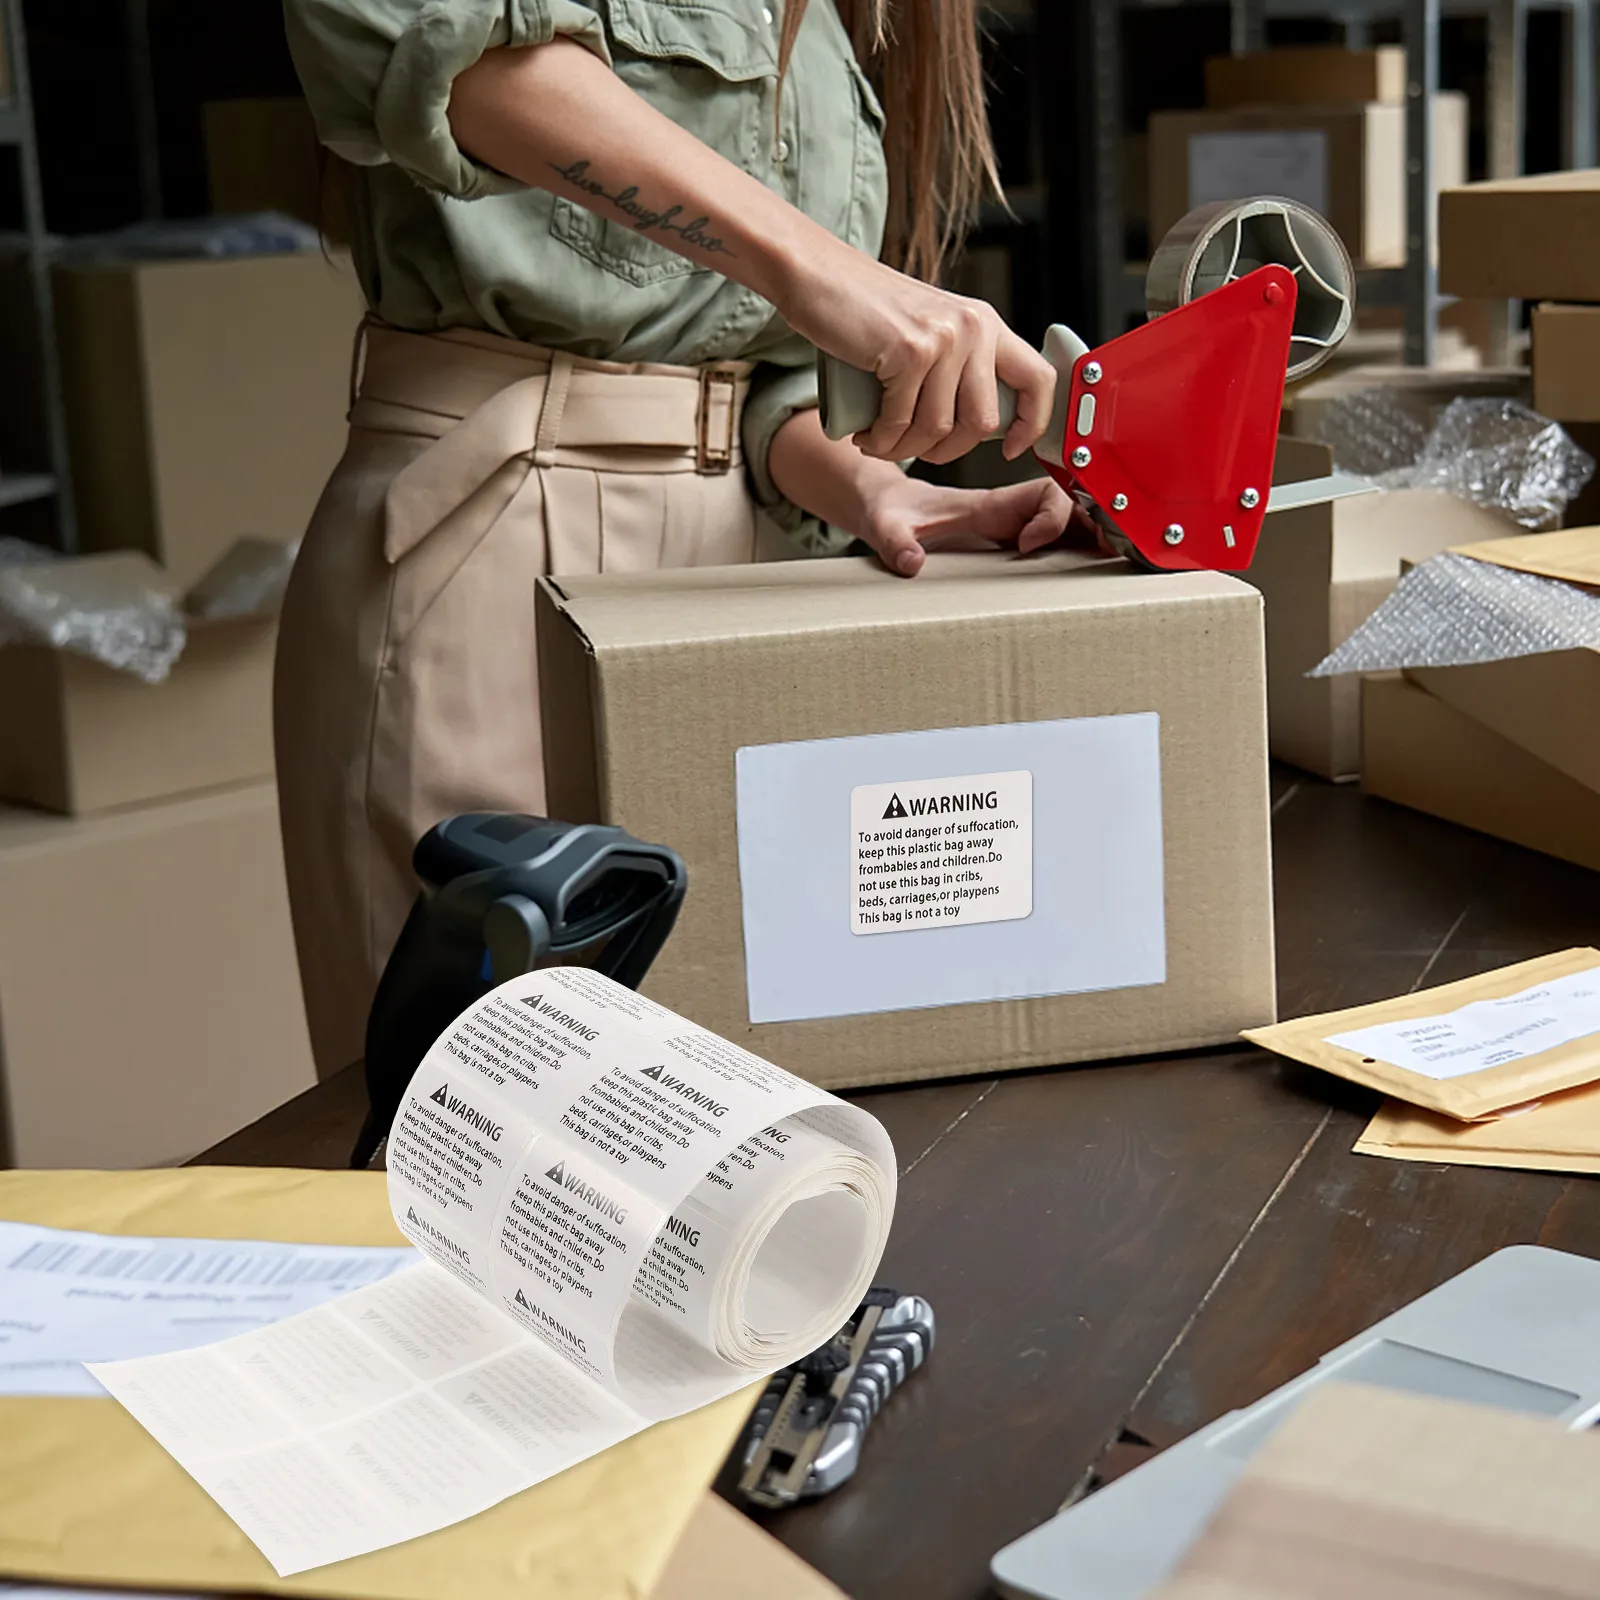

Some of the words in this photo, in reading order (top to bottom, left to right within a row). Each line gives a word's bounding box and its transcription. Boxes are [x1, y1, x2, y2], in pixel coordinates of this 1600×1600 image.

[909, 791, 998, 816] WARNING
[858, 831, 871, 843] To
[873, 828, 902, 842] avoid
[904, 827, 942, 839] danger
[944, 823, 956, 835] of
[957, 820, 1019, 834] suffocation,
[859, 848, 884, 860] keep
[886, 844, 906, 857] this
[908, 841, 942, 857] plastic
[944, 840, 964, 852] bag
[966, 838, 994, 849] away
[859, 860, 918, 876] frombabies
[920, 857, 940, 870] and
[942, 851, 1003, 867] children.Do
[859, 880, 877, 892] not
[879, 880, 897, 890] use
[899, 876, 919, 888] this
[921, 875, 940, 887] bag
[943, 873, 953, 884] in
[955, 870, 983, 883] cribs,
[859, 895, 887, 908] beds,
[889, 891, 951, 905] carriages,or
[953, 886, 1000, 902] playpens
[859, 912, 880, 924] This
[882, 911, 902, 924] bag
[905, 909, 913, 920] is
[915, 907, 933, 919] not
[935, 908, 941, 917] a
[943, 906, 960, 918] toy
[482, 1004, 500, 1018] keep
[498, 1014, 514, 1026] this
[509, 1022, 536, 1039] plastic
[533, 1034, 548, 1048] bag
[546, 1044, 567, 1059] away
[493, 996, 503, 1006] To
[500, 1002, 524, 1017] avoid
[519, 1014, 546, 1031] danger
[543, 1028, 556, 1036] of
[550, 1033, 591, 1060] suffocation,
[507, 1035, 525, 1047] and
[538, 1002, 600, 1042] WARNING
[444, 1041, 459, 1055] This
[457, 1049, 472, 1065] bag
[469, 1057, 478, 1067] is
[476, 1063, 491, 1075] not
[487, 1070, 495, 1078] a
[493, 1073, 507, 1086] toy
[452, 1031, 471, 1048] beds,
[506, 1067, 540, 1090] playpens
[461, 1023, 477, 1034] not
[473, 1030, 487, 1041] use
[485, 1036, 500, 1049] this
[498, 1044, 513, 1058] bag
[511, 1052, 521, 1062] in
[519, 1058, 538, 1074] cribs,
[447, 1095, 504, 1142] WARNING
[599, 1075, 619, 1090] keep
[617, 1086, 634, 1099] this
[629, 1095, 659, 1114] plastic
[656, 1109, 674, 1124] bag
[672, 1120, 695, 1136] away
[610, 1066, 622, 1077] To
[619, 1073, 645, 1089] avoid
[640, 1086, 670, 1105] danger
[667, 1102, 682, 1111] of
[675, 1107, 721, 1138] suffocation,
[629, 1109, 649, 1123] and
[660, 1074, 730, 1118] WARNING
[403, 1109, 420, 1127] keep
[419, 1121, 432, 1135] this
[430, 1130, 453, 1150] plastic
[451, 1142, 465, 1160] bag
[464, 1153, 483, 1171] away
[409, 1097, 418, 1109] To
[417, 1104, 437, 1122] avoid
[434, 1116, 459, 1136] danger
[457, 1132, 468, 1142] of
[464, 1137, 503, 1169] suffocation,
[559, 1114, 576, 1130] This
[574, 1124, 590, 1140] bag
[588, 1133, 598, 1143] is
[595, 1139, 612, 1152] not
[609, 1147, 616, 1156] a
[615, 1150, 630, 1164] toy
[568, 1103, 588, 1123] beds,
[629, 1144, 667, 1170] playpens
[578, 1095, 594, 1107] not
[591, 1102, 607, 1115] use
[605, 1110, 621, 1124] this
[619, 1118, 636, 1134] bag
[634, 1127, 644, 1139] in
[643, 1135, 664, 1152] cribs,
[395, 1137, 407, 1149] not
[406, 1144, 418, 1157] use
[418, 1151, 430, 1166] this
[429, 1159, 442, 1176] bag
[442, 1168, 450, 1180] in
[449, 1175, 466, 1193] cribs,
[433, 1147, 447, 1161] and
[393, 1147, 409, 1167] beds,
[444, 1187, 473, 1212] playpens
[564, 1173, 628, 1225] WARNING
[515, 1186, 533, 1206] keep
[532, 1199, 547, 1215] this
[545, 1210, 570, 1231] plastic
[569, 1224, 585, 1243] bag
[584, 1236, 605, 1256] away
[521, 1173, 531, 1186] To
[530, 1182, 552, 1201] avoid
[550, 1195, 577, 1217] danger
[576, 1213, 588, 1224] of
[584, 1219, 627, 1254] suffocation,
[548, 1228, 564, 1243] and
[419, 1218, 470, 1265] WARNING
[502, 1226, 520, 1247] beds,
[560, 1271, 593, 1298] playpens
[505, 1215, 519, 1229] not
[518, 1223, 531, 1238] use
[530, 1232, 545, 1247] this
[543, 1240, 558, 1259] bag
[558, 1251, 567, 1263] in
[566, 1259, 585, 1278] cribs,
[652, 1248, 666, 1264] bag
[666, 1258, 686, 1276] away
[655, 1237, 664, 1246] of
[663, 1239, 706, 1275] suffocation,
[500, 1238, 514, 1256] This
[513, 1249, 527, 1267] bag
[527, 1259, 534, 1271] is
[533, 1266, 547, 1280] not
[546, 1275, 551, 1284] a
[552, 1278, 564, 1294] toy
[649, 1260, 689, 1292] children.Do
[656, 1277, 675, 1297] cribs,
[529, 1301, 587, 1354] WARNING
